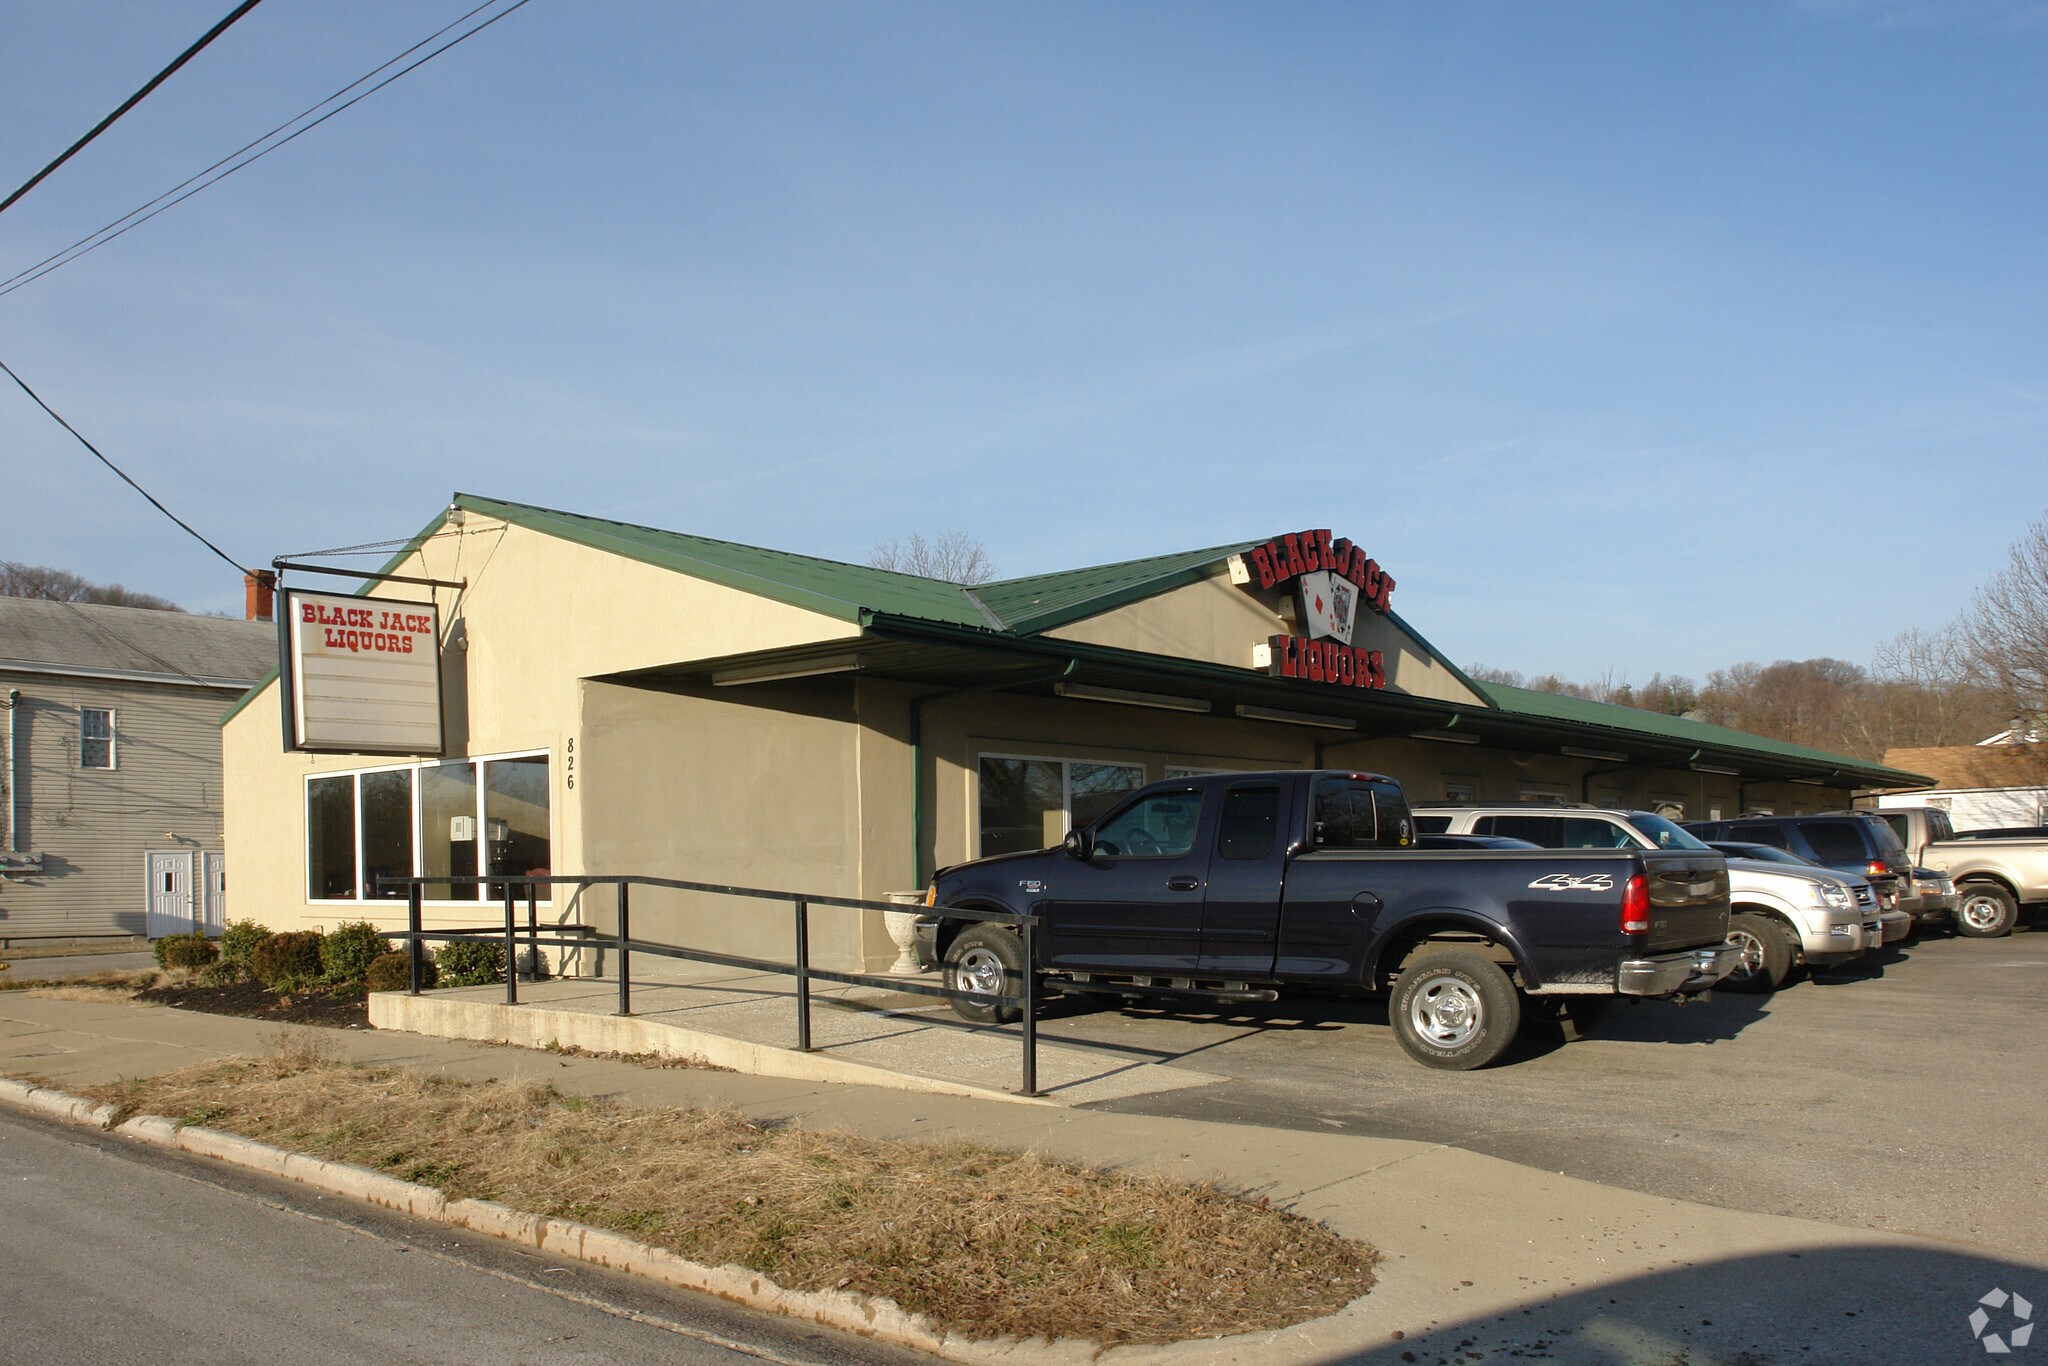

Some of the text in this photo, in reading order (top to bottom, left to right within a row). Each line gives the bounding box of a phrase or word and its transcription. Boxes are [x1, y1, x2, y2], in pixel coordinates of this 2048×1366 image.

[302, 603, 431, 634] BLACK JACK
[325, 628, 413, 654] LIQUORS
[1278, 634, 1386, 690] LIQUORS
